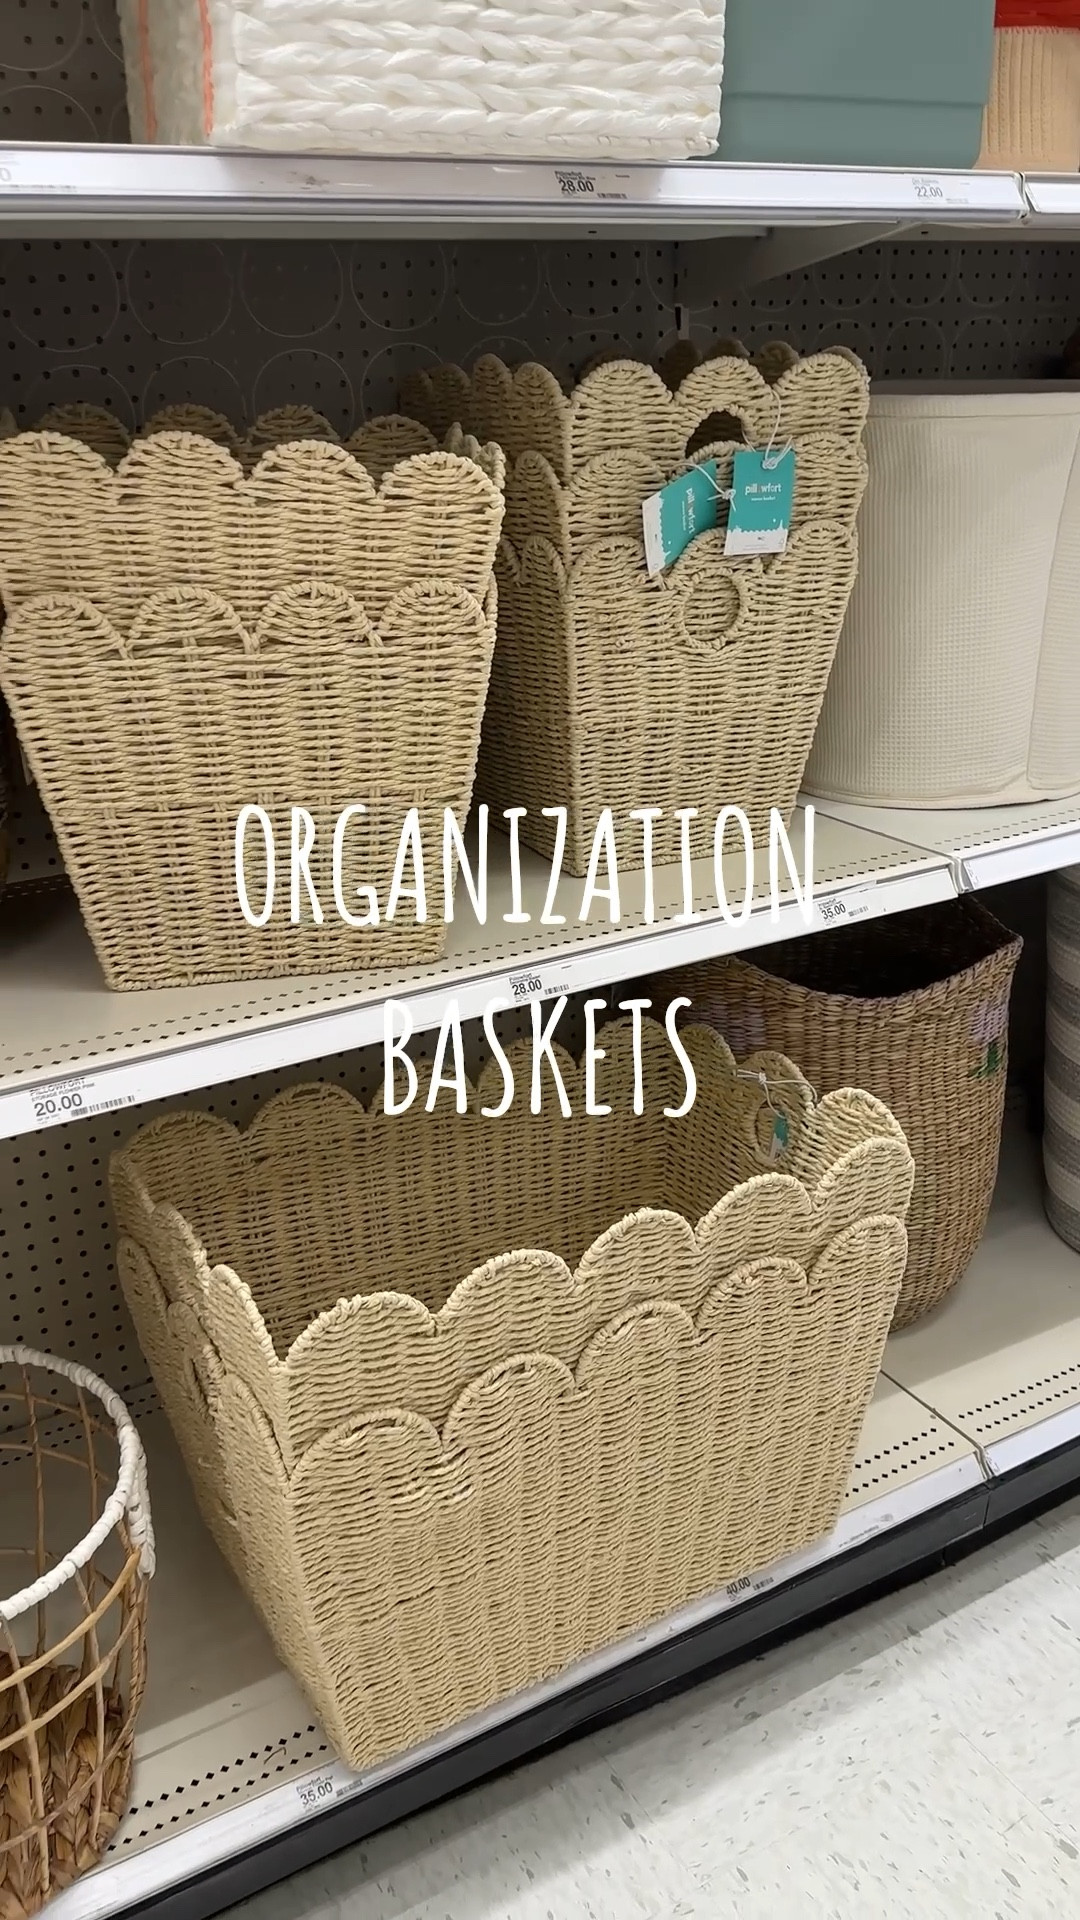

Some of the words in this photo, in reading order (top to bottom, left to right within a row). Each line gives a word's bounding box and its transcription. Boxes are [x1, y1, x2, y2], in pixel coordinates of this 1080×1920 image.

[558, 179, 595, 193] 28.00
[914, 185, 943, 198] 22.00
[744, 482, 782, 496] pillwfort
[685, 487, 697, 535] pillwfort
[821, 902, 847, 920] 35.00
[511, 978, 543, 996] 28.00
[33, 1092, 83, 1117] 20.00
[726, 1576, 751, 1595] 40.00
[300, 1781, 333, 1806] 35.00
